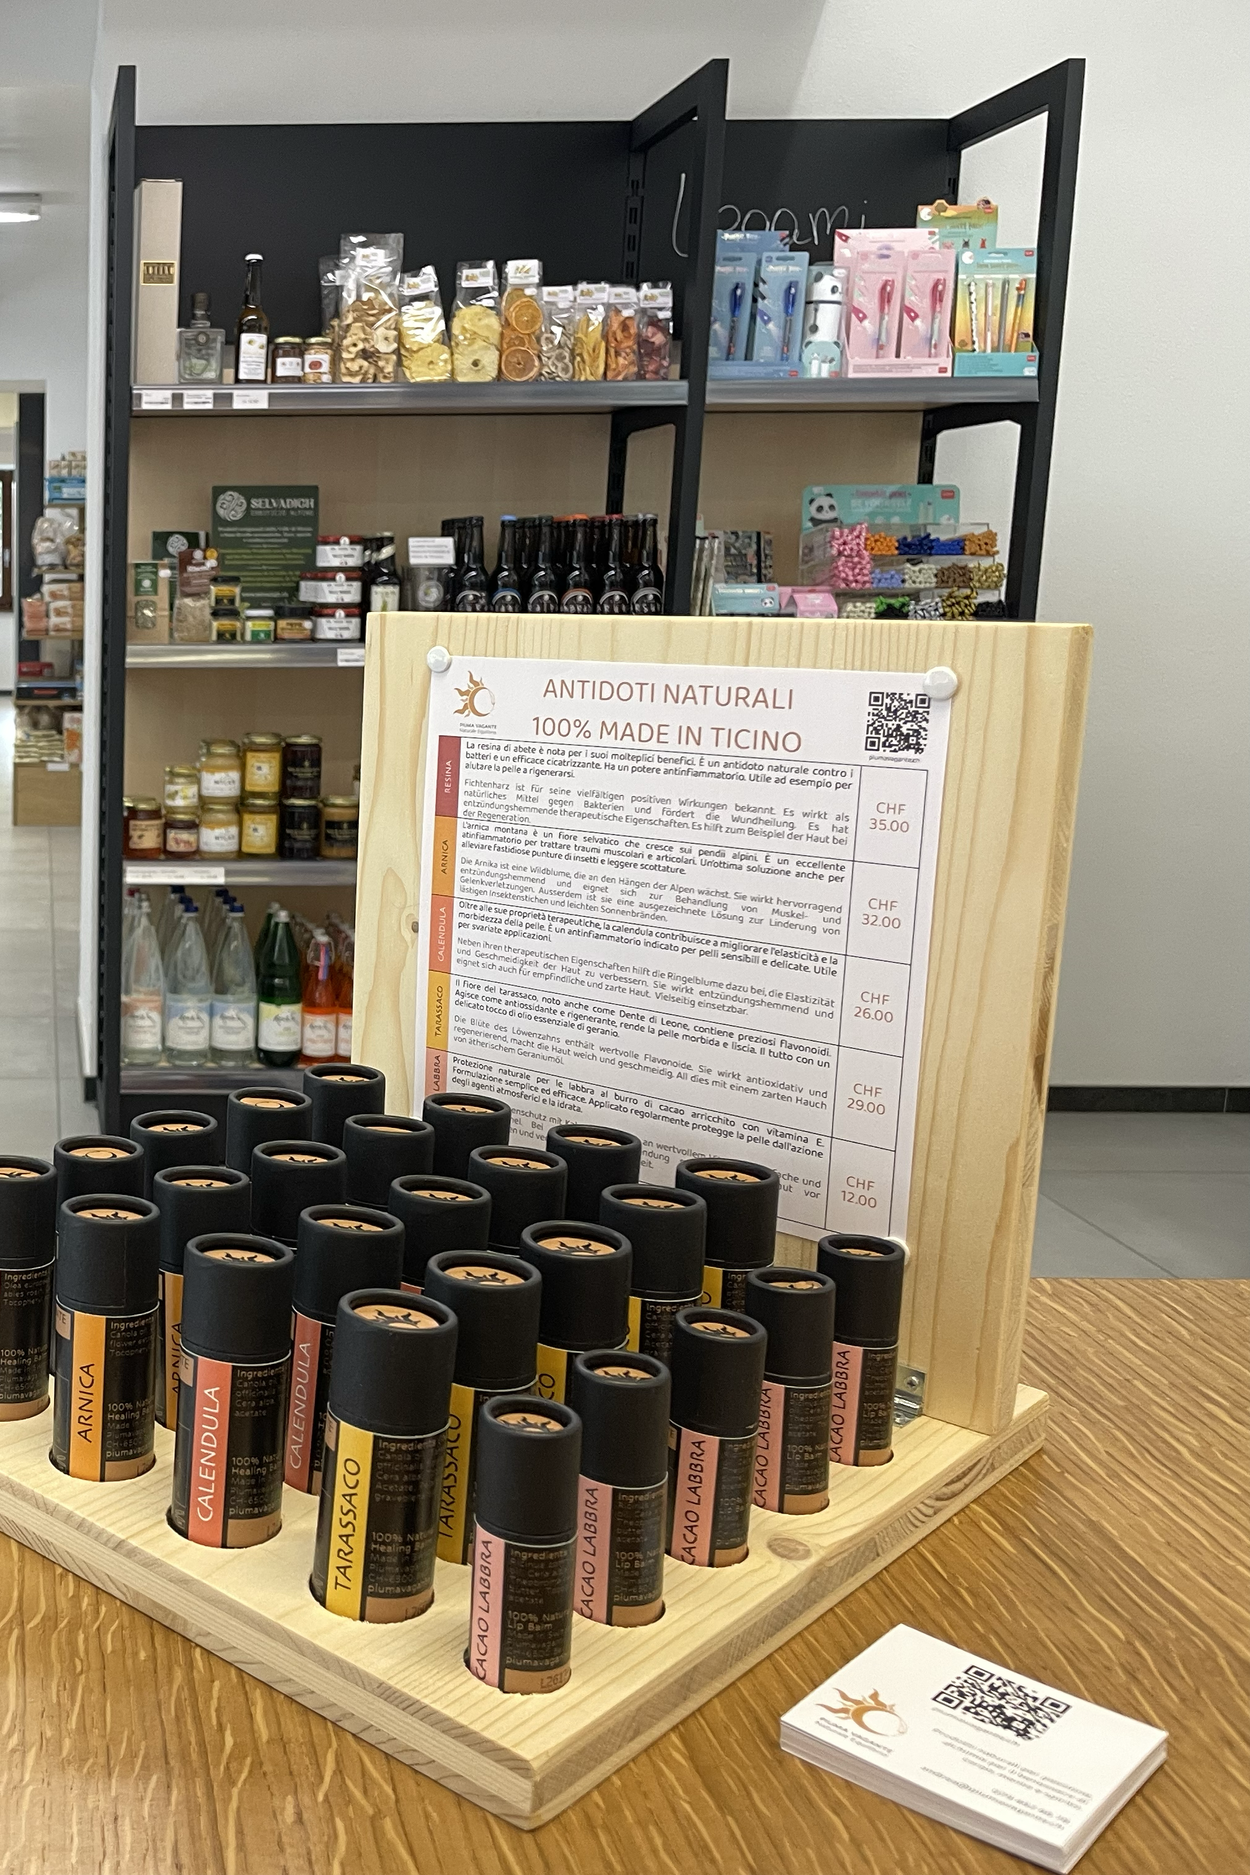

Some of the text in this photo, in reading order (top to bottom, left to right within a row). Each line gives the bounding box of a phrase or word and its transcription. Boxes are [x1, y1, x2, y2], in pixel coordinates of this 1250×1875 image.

[543, 678, 793, 710] ANTIDOTI NATURALI
[533, 716, 802, 753] 100% MADE IN TICINO
[444, 760, 452, 793] RESINA
[465, 750, 491, 760] batteri
[511, 754, 545, 764] efficace
[630, 763, 661, 775] potere
[748, 772, 772, 783] Utile
[788, 775, 832, 789] esempio
[834, 781, 853, 791] per
[869, 817, 910, 833] 35.00
[876, 801, 906, 816] CHF
[441, 839, 449, 875] ARNICA
[461, 829, 522, 844] atinfiammatorio
[524, 839, 537, 847] per
[539, 839, 571, 850] trattare
[573, 842, 601, 853] traumi
[603, 846, 644, 859] muscolari
[745, 863, 792, 876] soluzione
[794, 868, 825, 880] anche
[827, 874, 845, 884] per
[459, 865, 842, 925] entzündungshemmend und eignet sich zur Behandlung von Muskel- und
[867, 898, 898, 912] CHF
[438, 906, 447, 962] CALENDULA
[861, 914, 902, 930] 32.00
[458, 909, 502, 923] morbidezza
[503, 916, 523, 927] della
[567, 926, 641, 945] antinfiammatorio
[643, 938, 679, 951] indicato
[680, 946, 697, 956] per
[698, 946, 719, 959] pelli
[720, 950, 760, 964] sensibili
[813, 964, 838, 976] Utile
[435, 985, 444, 1037] TARASSACO
[462, 979, 481, 990] fiore
[483, 983, 496, 992] del
[541, 994, 561, 1005] noto
[563, 998, 589, 1010] anche
[591, 1005, 616, 1015] come
[618, 1008, 646, 1021] Dente
[692, 1022, 735, 1038] contiene
[737, 1030, 776, 1047] preziosi
[853, 1006, 894, 1023] 26.00
[860, 991, 890, 1006] CHF
[433, 1054, 441, 1092] LABBRA
[853, 1083, 883, 1098] CHF
[452, 1065, 503, 1084] Formulazione
[504, 1077, 539, 1093] semplice
[587, 1096, 629, 1114] Applicato
[629, 1105, 690, 1129] regolarmente
[691, 1120, 734, 1139] protegge
[746, 1132, 770, 1147] pelle
[846, 1098, 886, 1116] 29.00
[841, 1190, 877, 1209] 12.00
[846, 1176, 875, 1191] CHF
[0, 1349, 25, 1358] 100%
[833, 1350, 851, 1410] LABBRA
[77, 1363, 95, 1443] ARNICA
[108, 1402, 133, 1412] 100%
[290, 1342, 311, 1470] CALENDULA
[197, 1386, 221, 1522] CALENDULA
[231, 1456, 260, 1466] 100%
[754, 1388, 772, 1508] CACAO LABBRA
[440, 1413, 462, 1539] TARASSACO
[686, 1440, 707, 1506] LABBRA
[334, 1458, 361, 1591] TARASSACO
[583, 1488, 599, 1557] LABBRA
[475, 1540, 492, 1681] CACAO LABBRA
[507, 1619, 524, 1631] Lip
[508, 1610, 539, 1623] 100%
